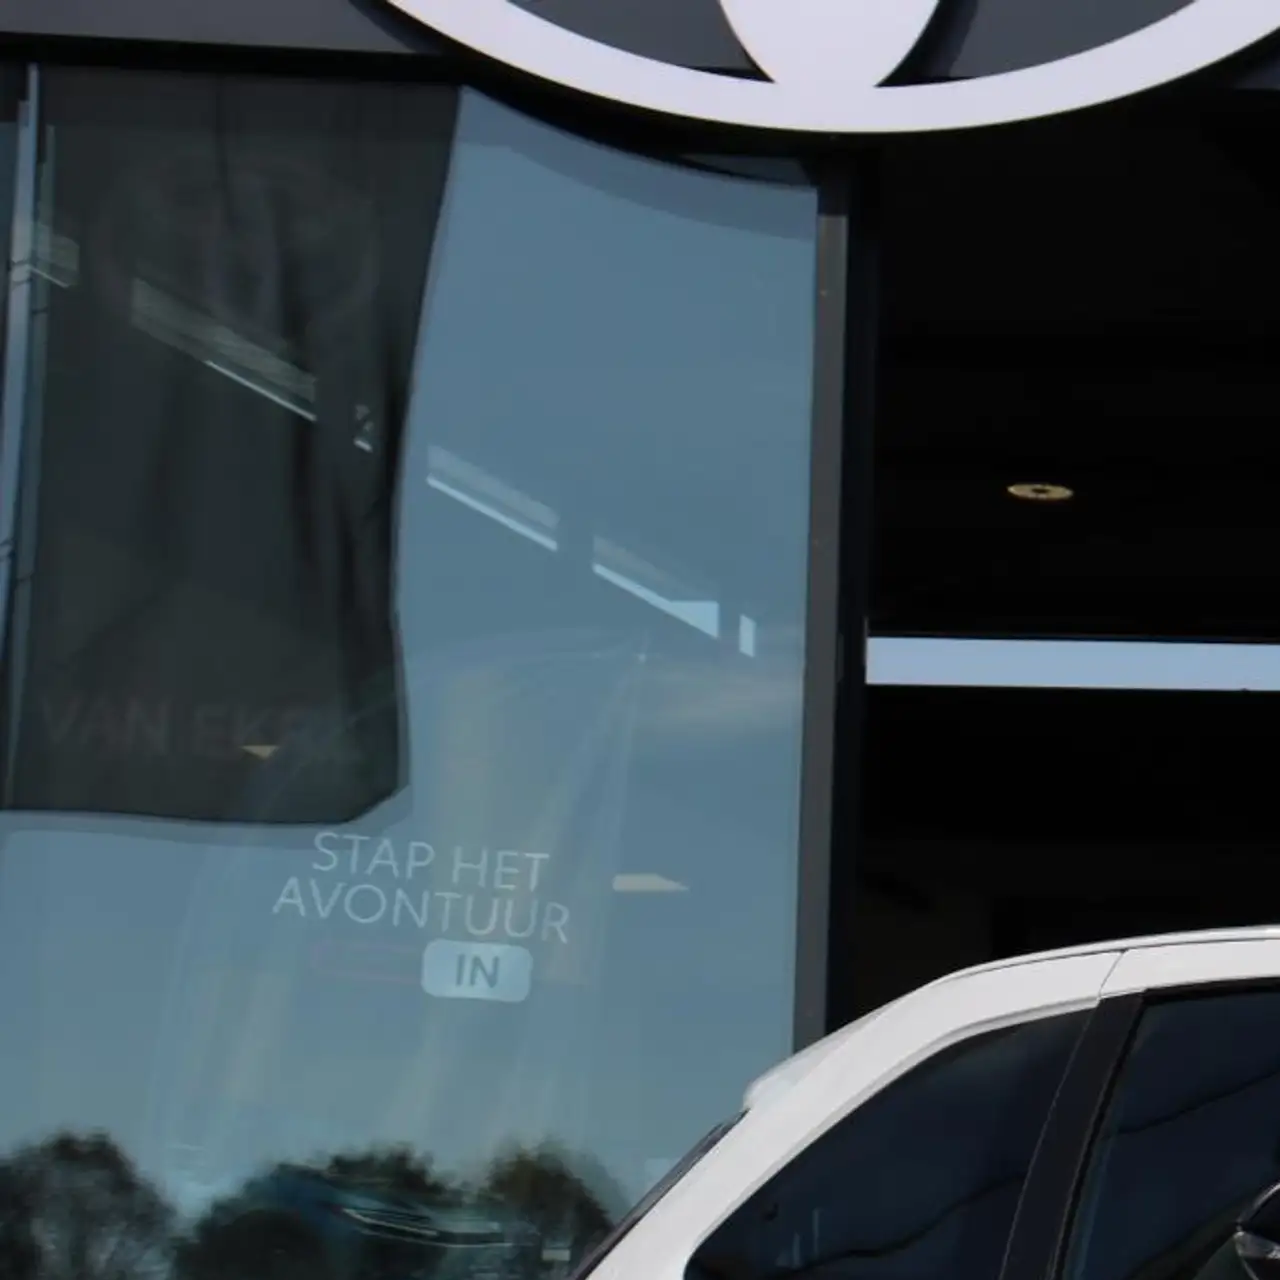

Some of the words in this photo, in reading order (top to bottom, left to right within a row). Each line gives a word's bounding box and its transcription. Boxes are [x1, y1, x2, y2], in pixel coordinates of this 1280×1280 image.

[40, 693, 172, 756] VAN
[311, 831, 436, 880] STAP
[452, 845, 550, 892] HET
[271, 876, 570, 944] AVONTUUR
[455, 954, 500, 988] IN
